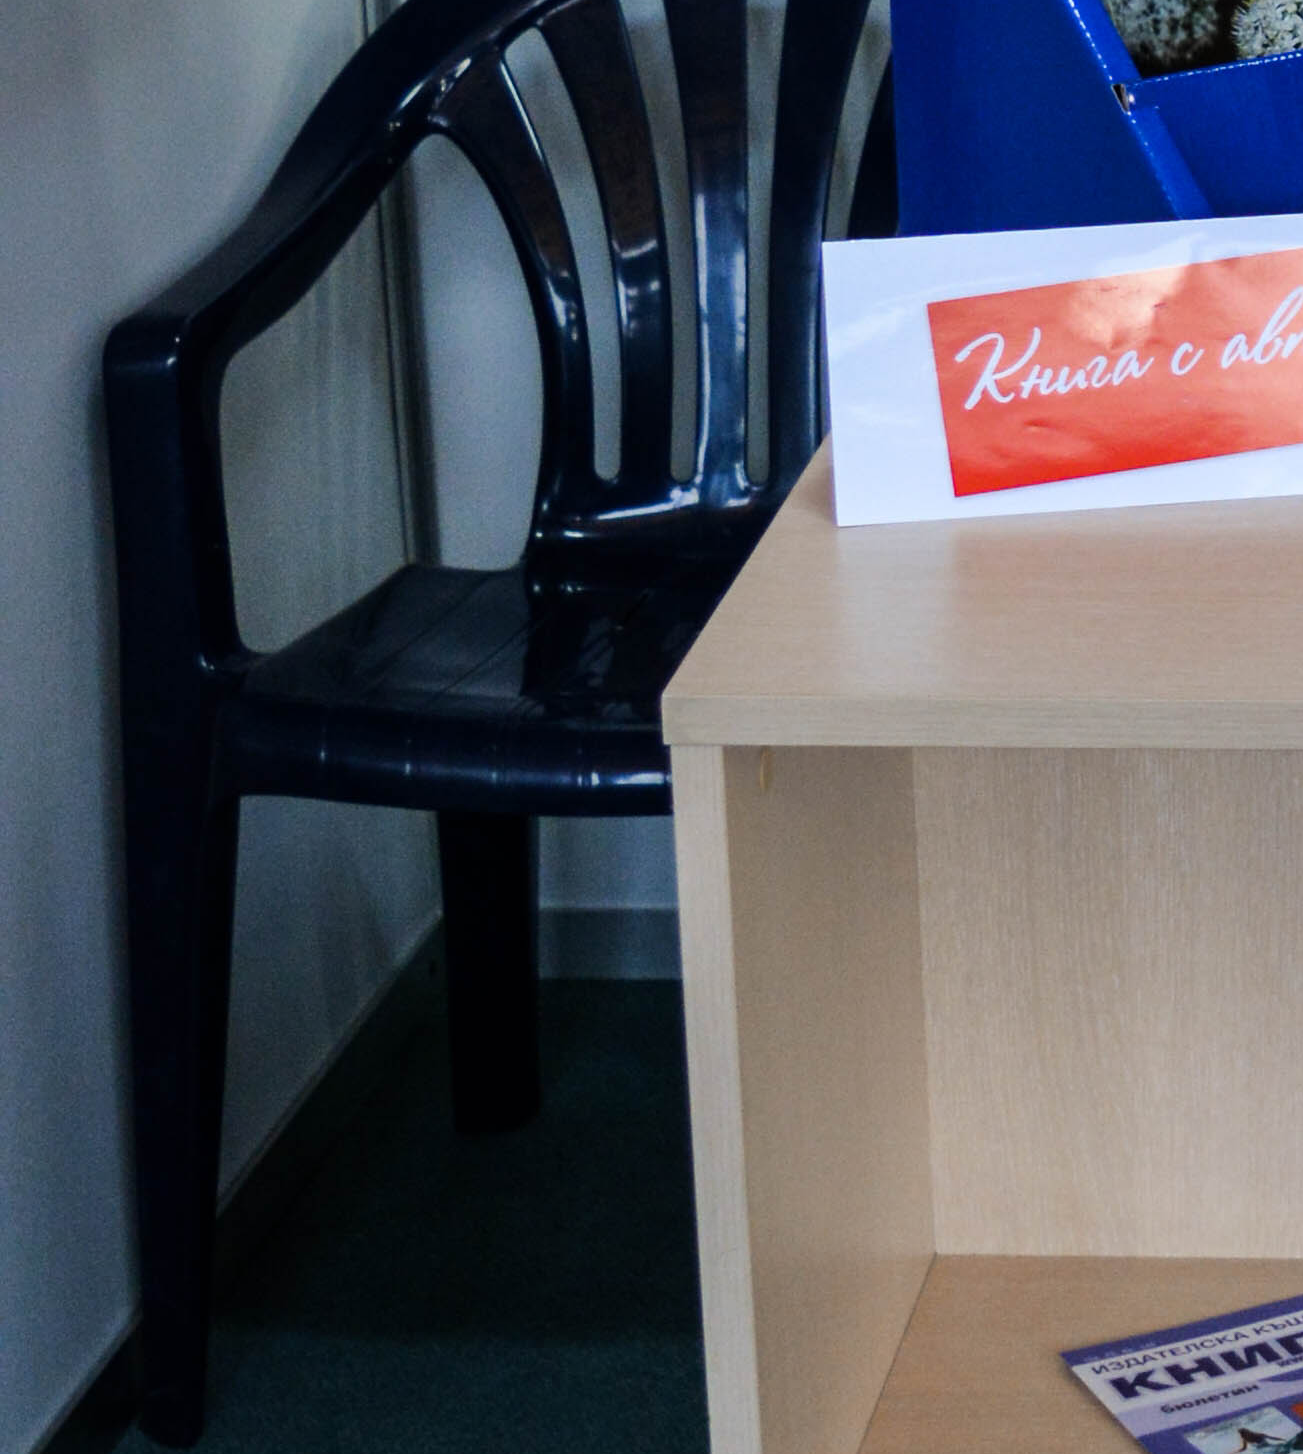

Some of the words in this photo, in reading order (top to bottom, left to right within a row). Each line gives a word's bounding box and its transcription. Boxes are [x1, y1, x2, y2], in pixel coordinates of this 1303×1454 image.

[954, 327, 1154, 411] Книга
[1170, 343, 1204, 378] с
[1090, 1329, 1249, 1376] ИЗДАТЕЛСКА
